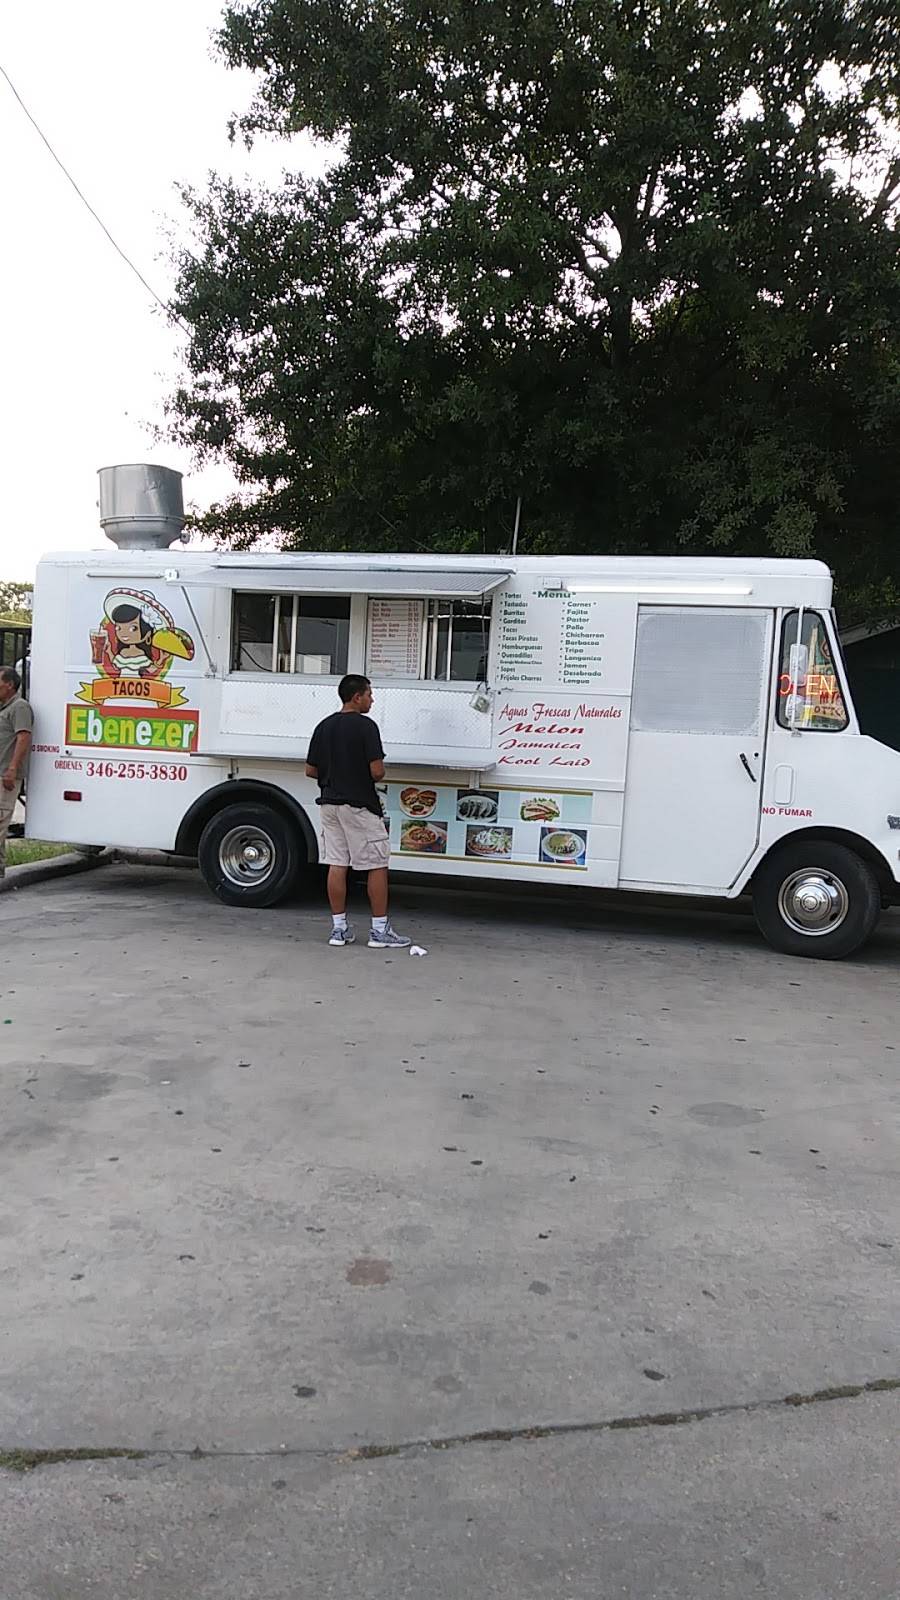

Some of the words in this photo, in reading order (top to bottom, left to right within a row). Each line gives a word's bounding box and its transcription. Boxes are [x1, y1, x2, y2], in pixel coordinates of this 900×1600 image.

[112, 681, 150, 696] TACOS
[499, 704, 528, 720] Aguas
[532, 703, 571, 721] Frescas
[574, 704, 622, 720] Naturales
[70, 709, 195, 748] Ebenezer
[498, 723, 584, 735] Melon
[498, 739, 581, 750] Jamaica
[498, 756, 541, 765] Kool
[549, 757, 591, 766] Laid
[55, 760, 82, 770] ORDENES
[86, 761, 187, 781] 346-255-3830
[779, 808, 813, 817] FUMAR
